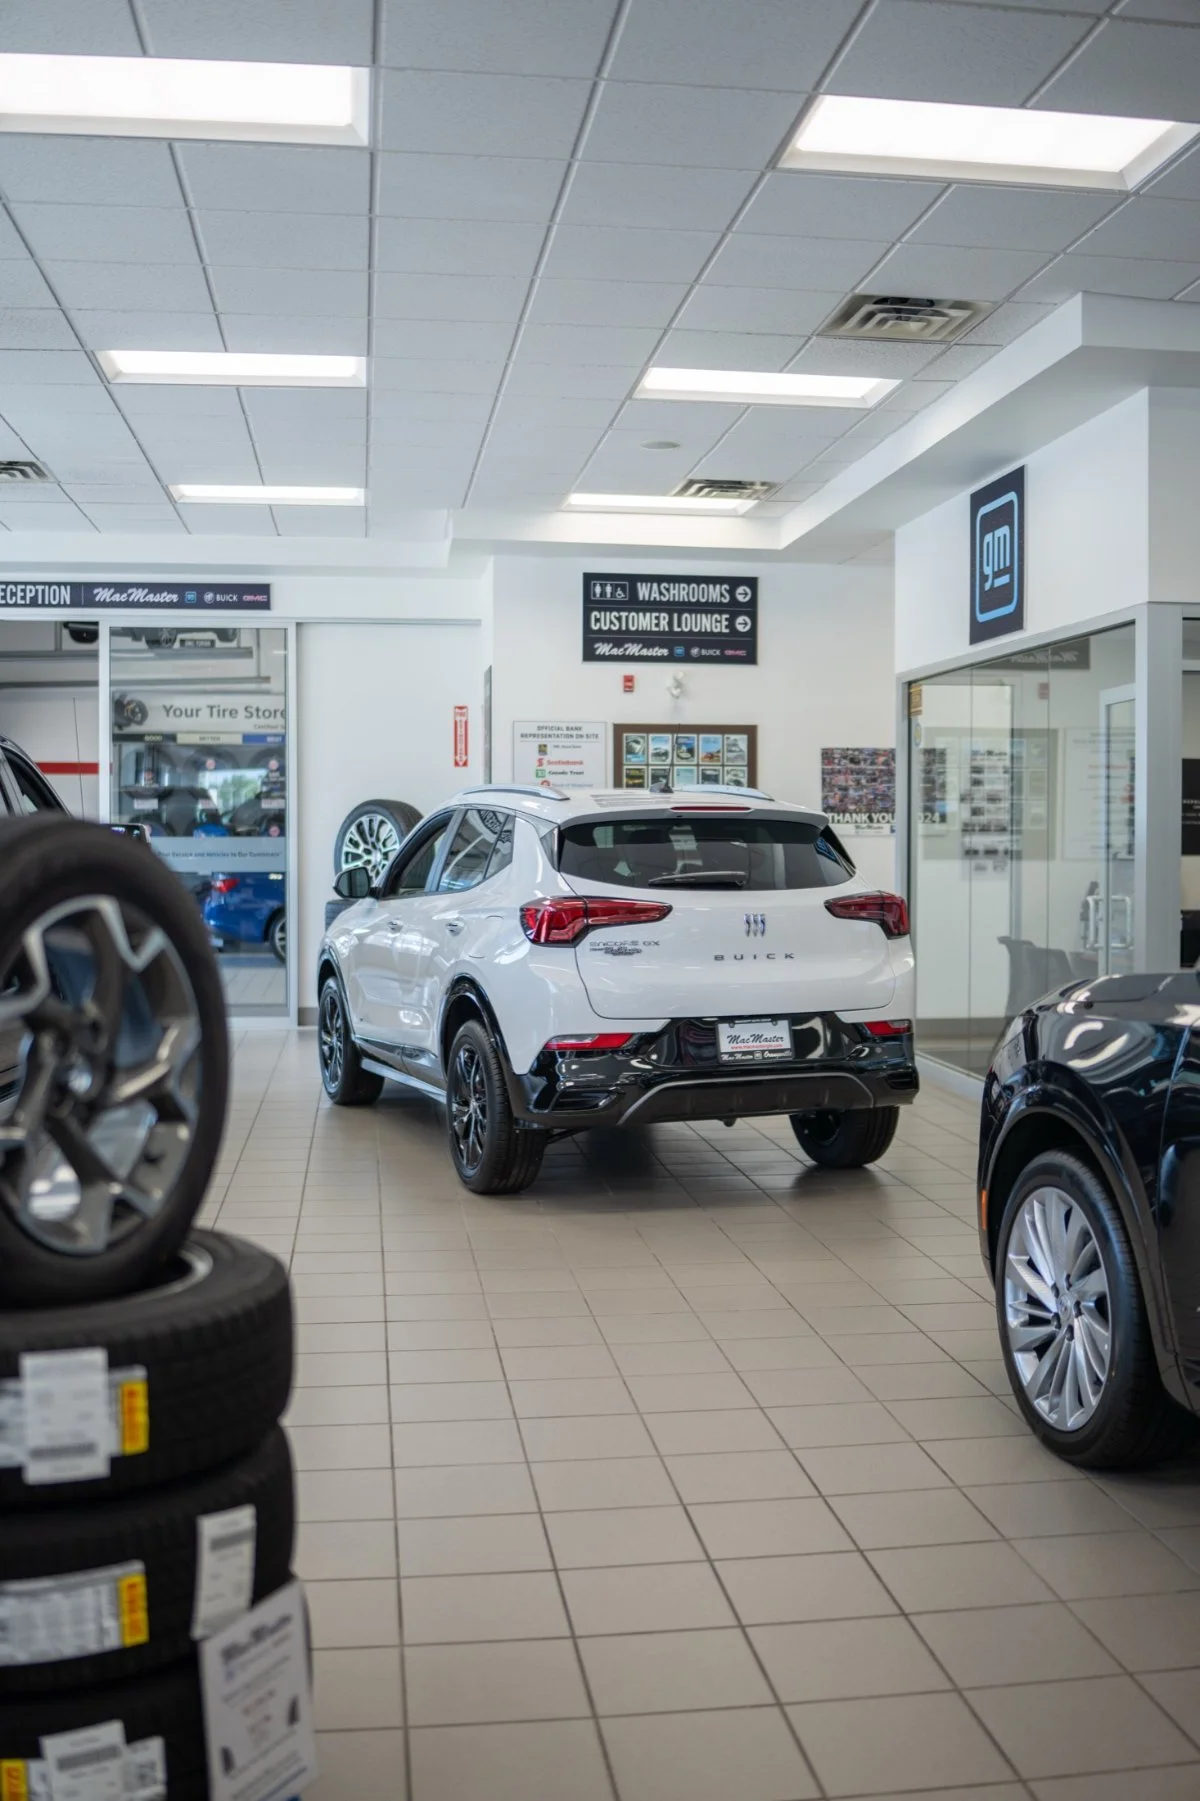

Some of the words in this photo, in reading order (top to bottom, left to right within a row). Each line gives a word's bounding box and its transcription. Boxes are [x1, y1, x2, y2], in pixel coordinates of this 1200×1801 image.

[983, 525, 1010, 591] gm
[0, 585, 71, 605] ECEPTION
[93, 587, 180, 603] MacMaster
[216, 594, 238, 602] BUICK
[637, 582, 730, 603] WASHROOMS
[590, 611, 669, 631] CUSTOMER
[673, 613, 730, 633] LOUNGE
[593, 643, 670, 657] MacMaster
[701, 648, 721, 656] BUICK
[162, 704, 203, 719] Your
[206, 704, 239, 719] Tire
[829, 812, 870, 824] THANK
[714, 953, 794, 961] BUICK
[726, 1033, 784, 1044] MacMaster
